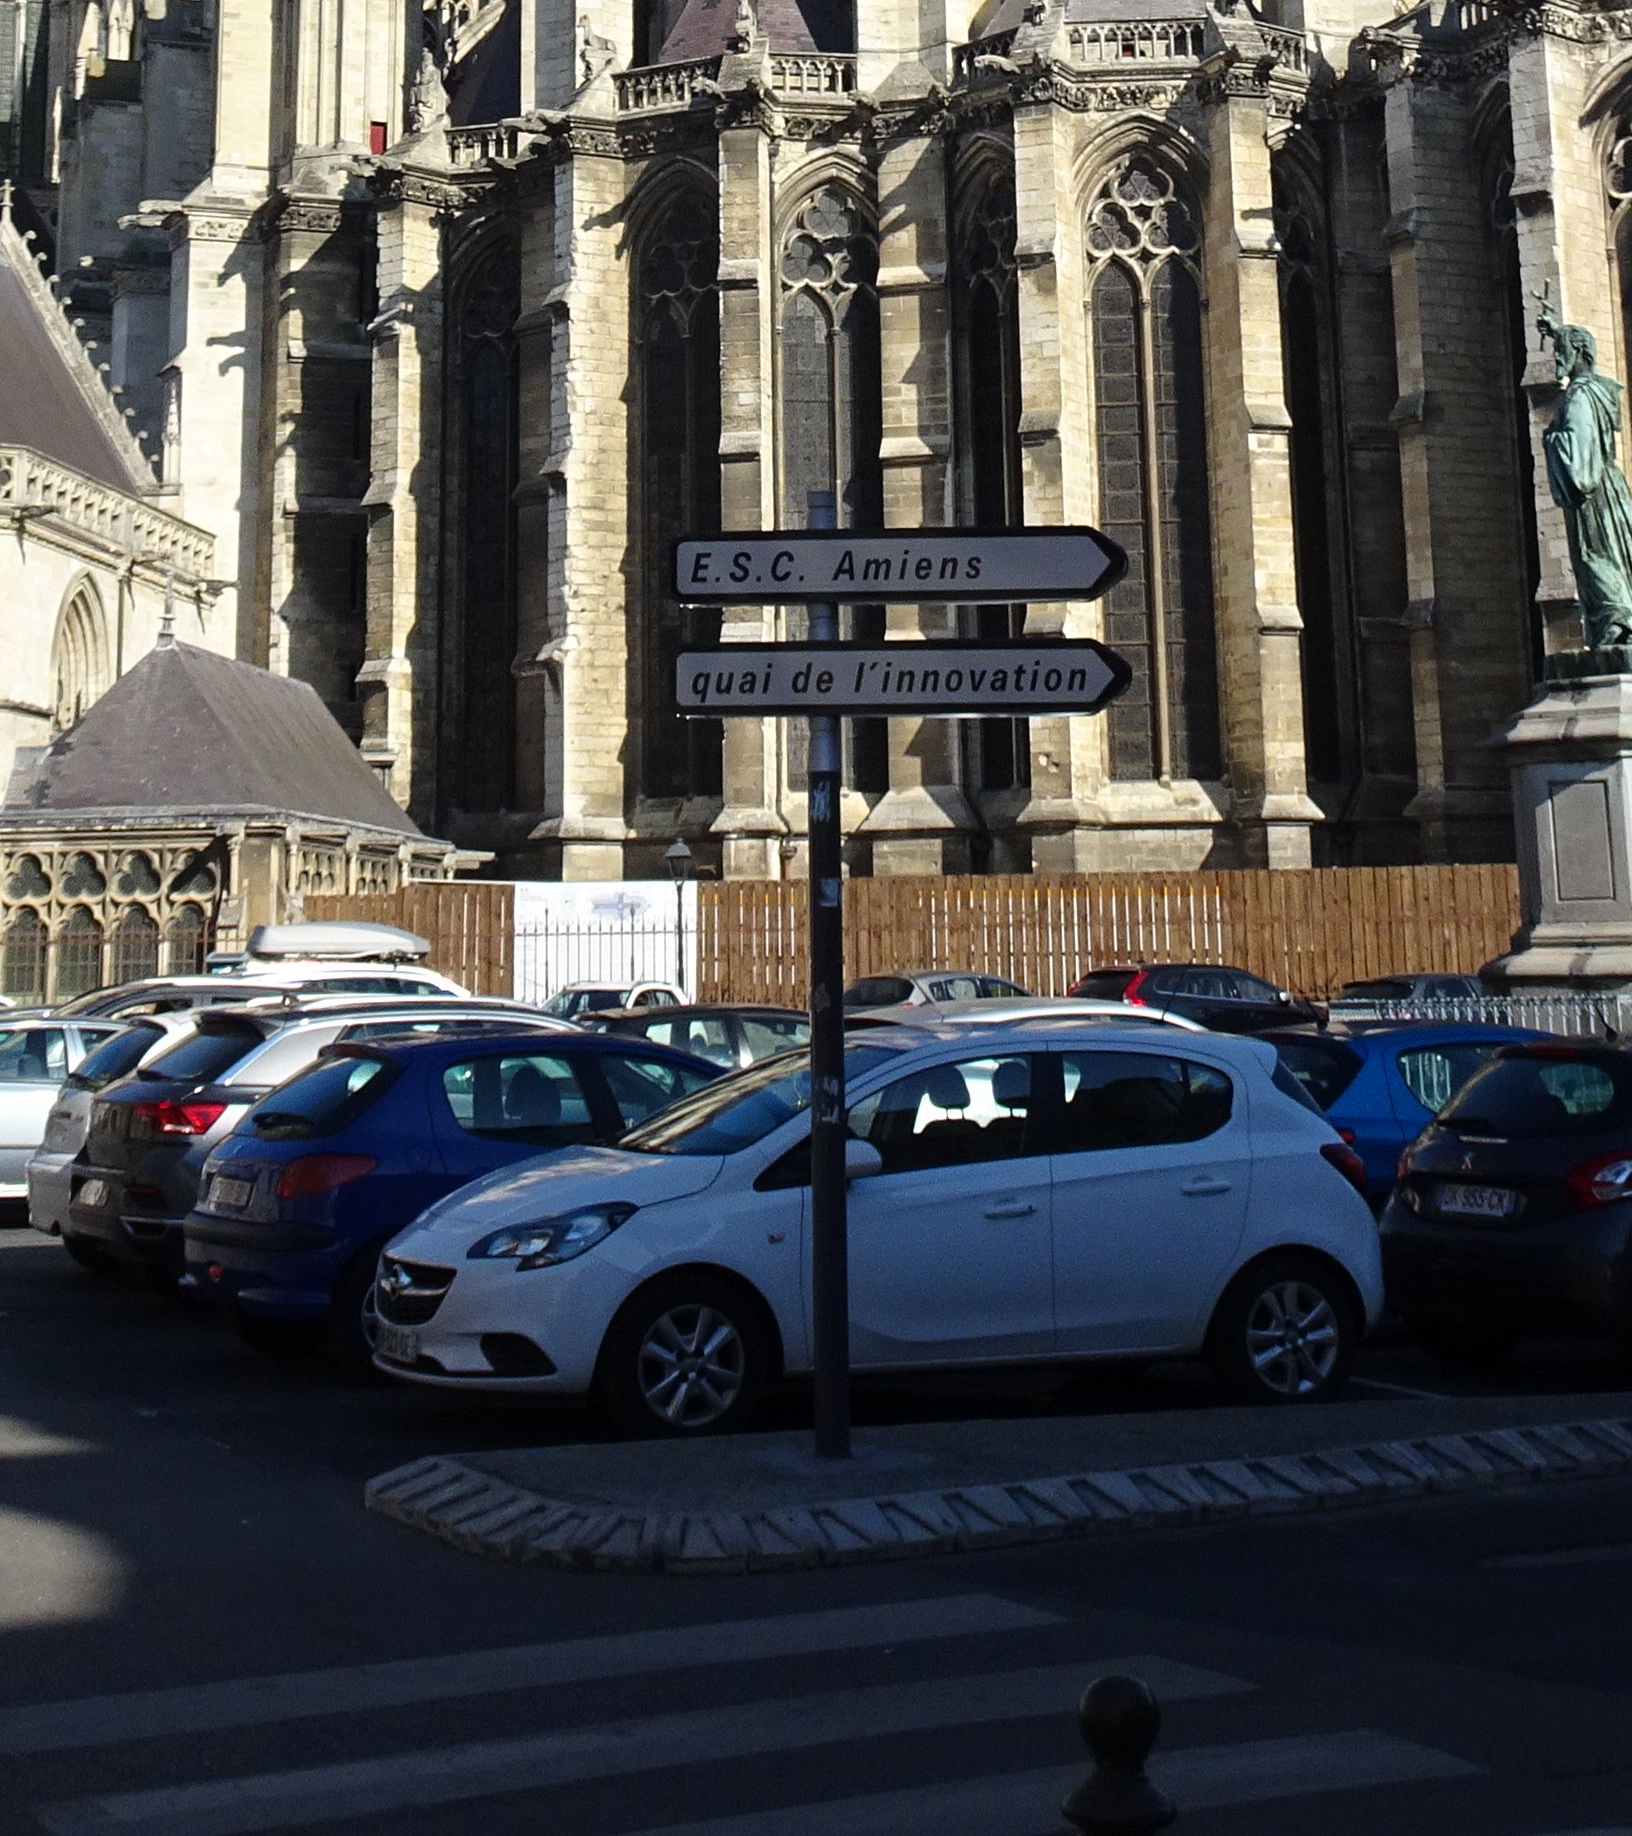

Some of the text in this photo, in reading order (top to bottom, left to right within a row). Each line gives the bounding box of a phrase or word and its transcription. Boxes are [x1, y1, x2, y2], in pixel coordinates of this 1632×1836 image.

[690, 549, 982, 584] E.S.C. Amiens
[691, 659, 1087, 703] quai de l'innovation
